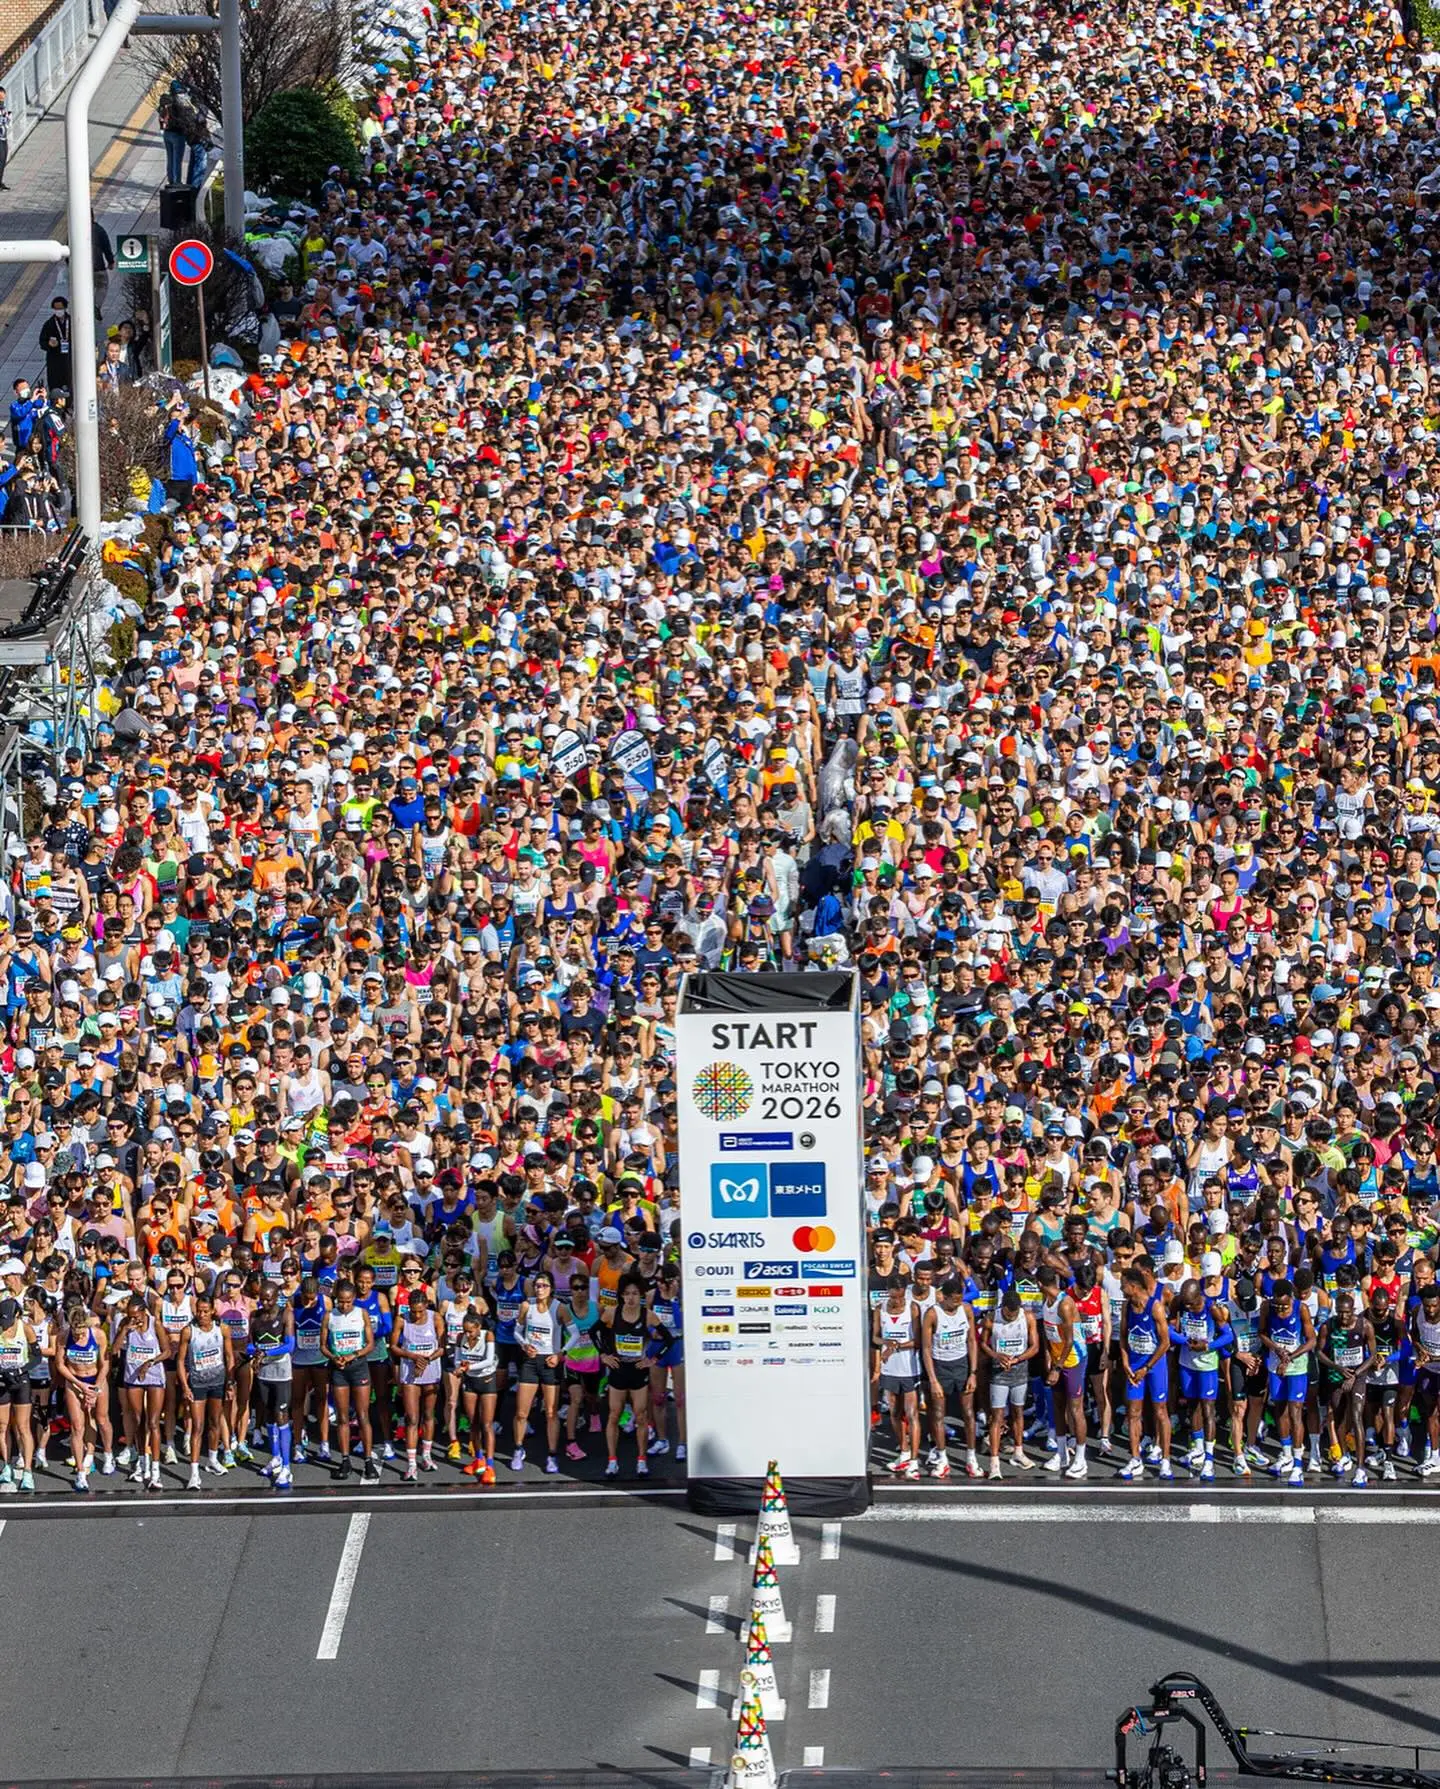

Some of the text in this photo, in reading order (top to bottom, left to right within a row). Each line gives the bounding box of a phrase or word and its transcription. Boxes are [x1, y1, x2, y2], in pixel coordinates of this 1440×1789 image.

[564, 753, 584, 771] 2:50
[626, 748, 648, 768] 2:50
[711, 1022, 818, 1050] START
[760, 1061, 840, 1079] TOKYO
[762, 1082, 840, 1093] MARATHON
[762, 1097, 841, 1119] 2026
[774, 1185, 822, 1195] 東京メトロ
[708, 1232, 765, 1248] STARTS
[762, 1264, 793, 1275] asics
[760, 1521, 789, 1531] TOKYO
[755, 1676, 773, 1685] KYO
[745, 1760, 765, 1771] KYO
